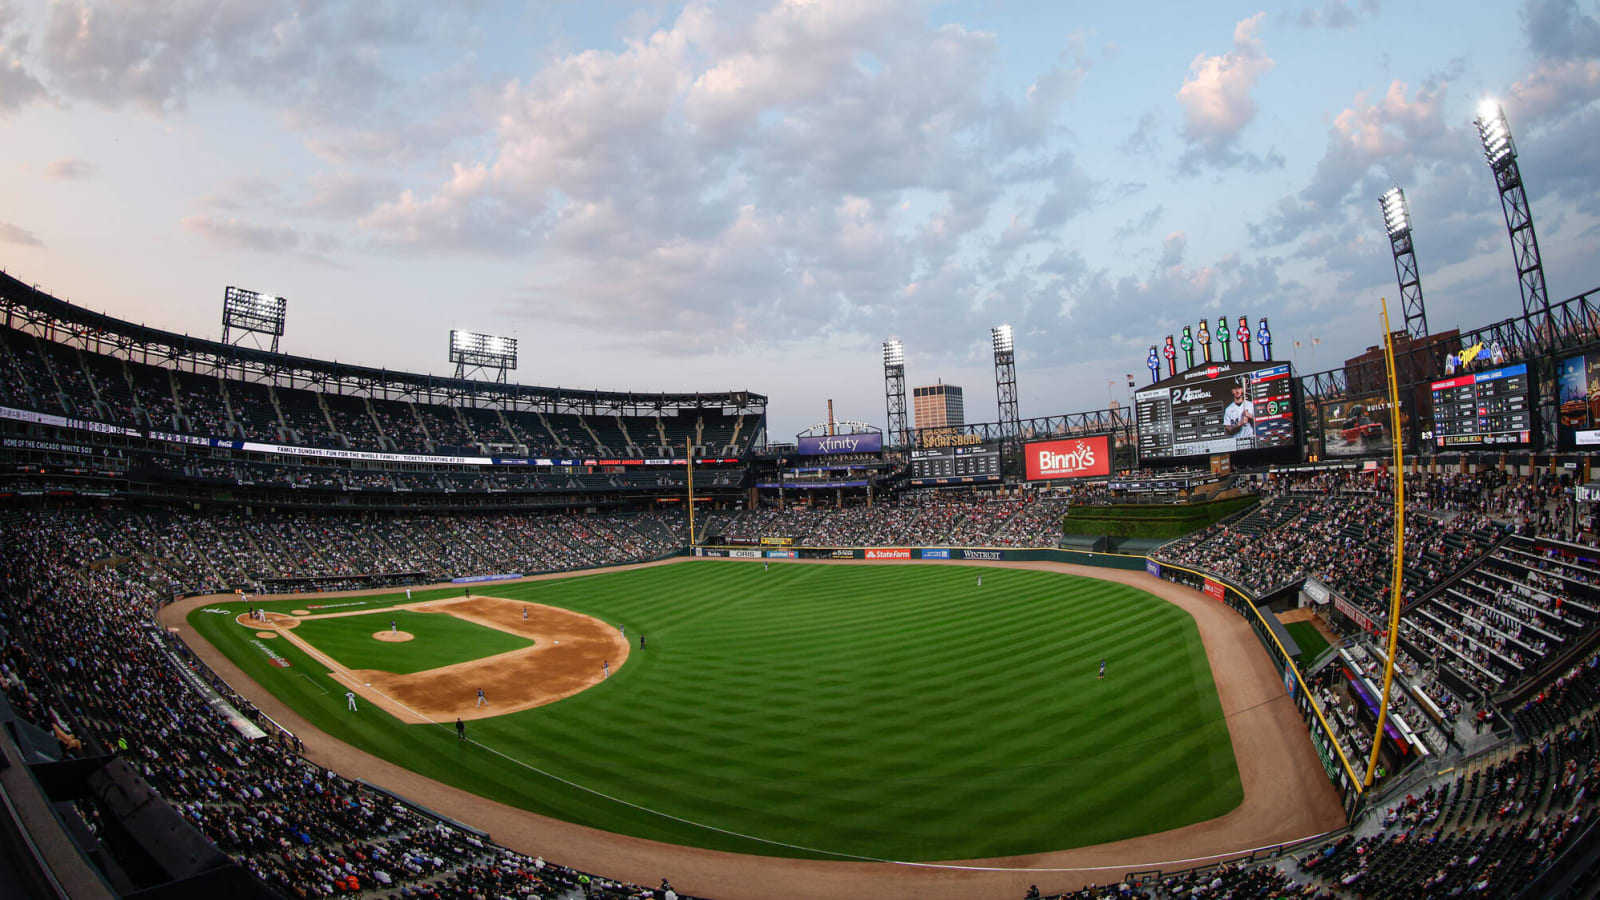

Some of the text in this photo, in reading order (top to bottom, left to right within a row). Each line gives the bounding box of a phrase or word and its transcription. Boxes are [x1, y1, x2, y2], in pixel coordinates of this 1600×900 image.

[1172, 387, 1191, 404] 24
[36, 441, 60, 450] CHICAGO
[81, 446, 93, 454] SOX
[819, 437, 860, 454] xfinity
[924, 433, 982, 448] SPORTSBOOK
[963, 550, 1001, 559] WINTRUST
